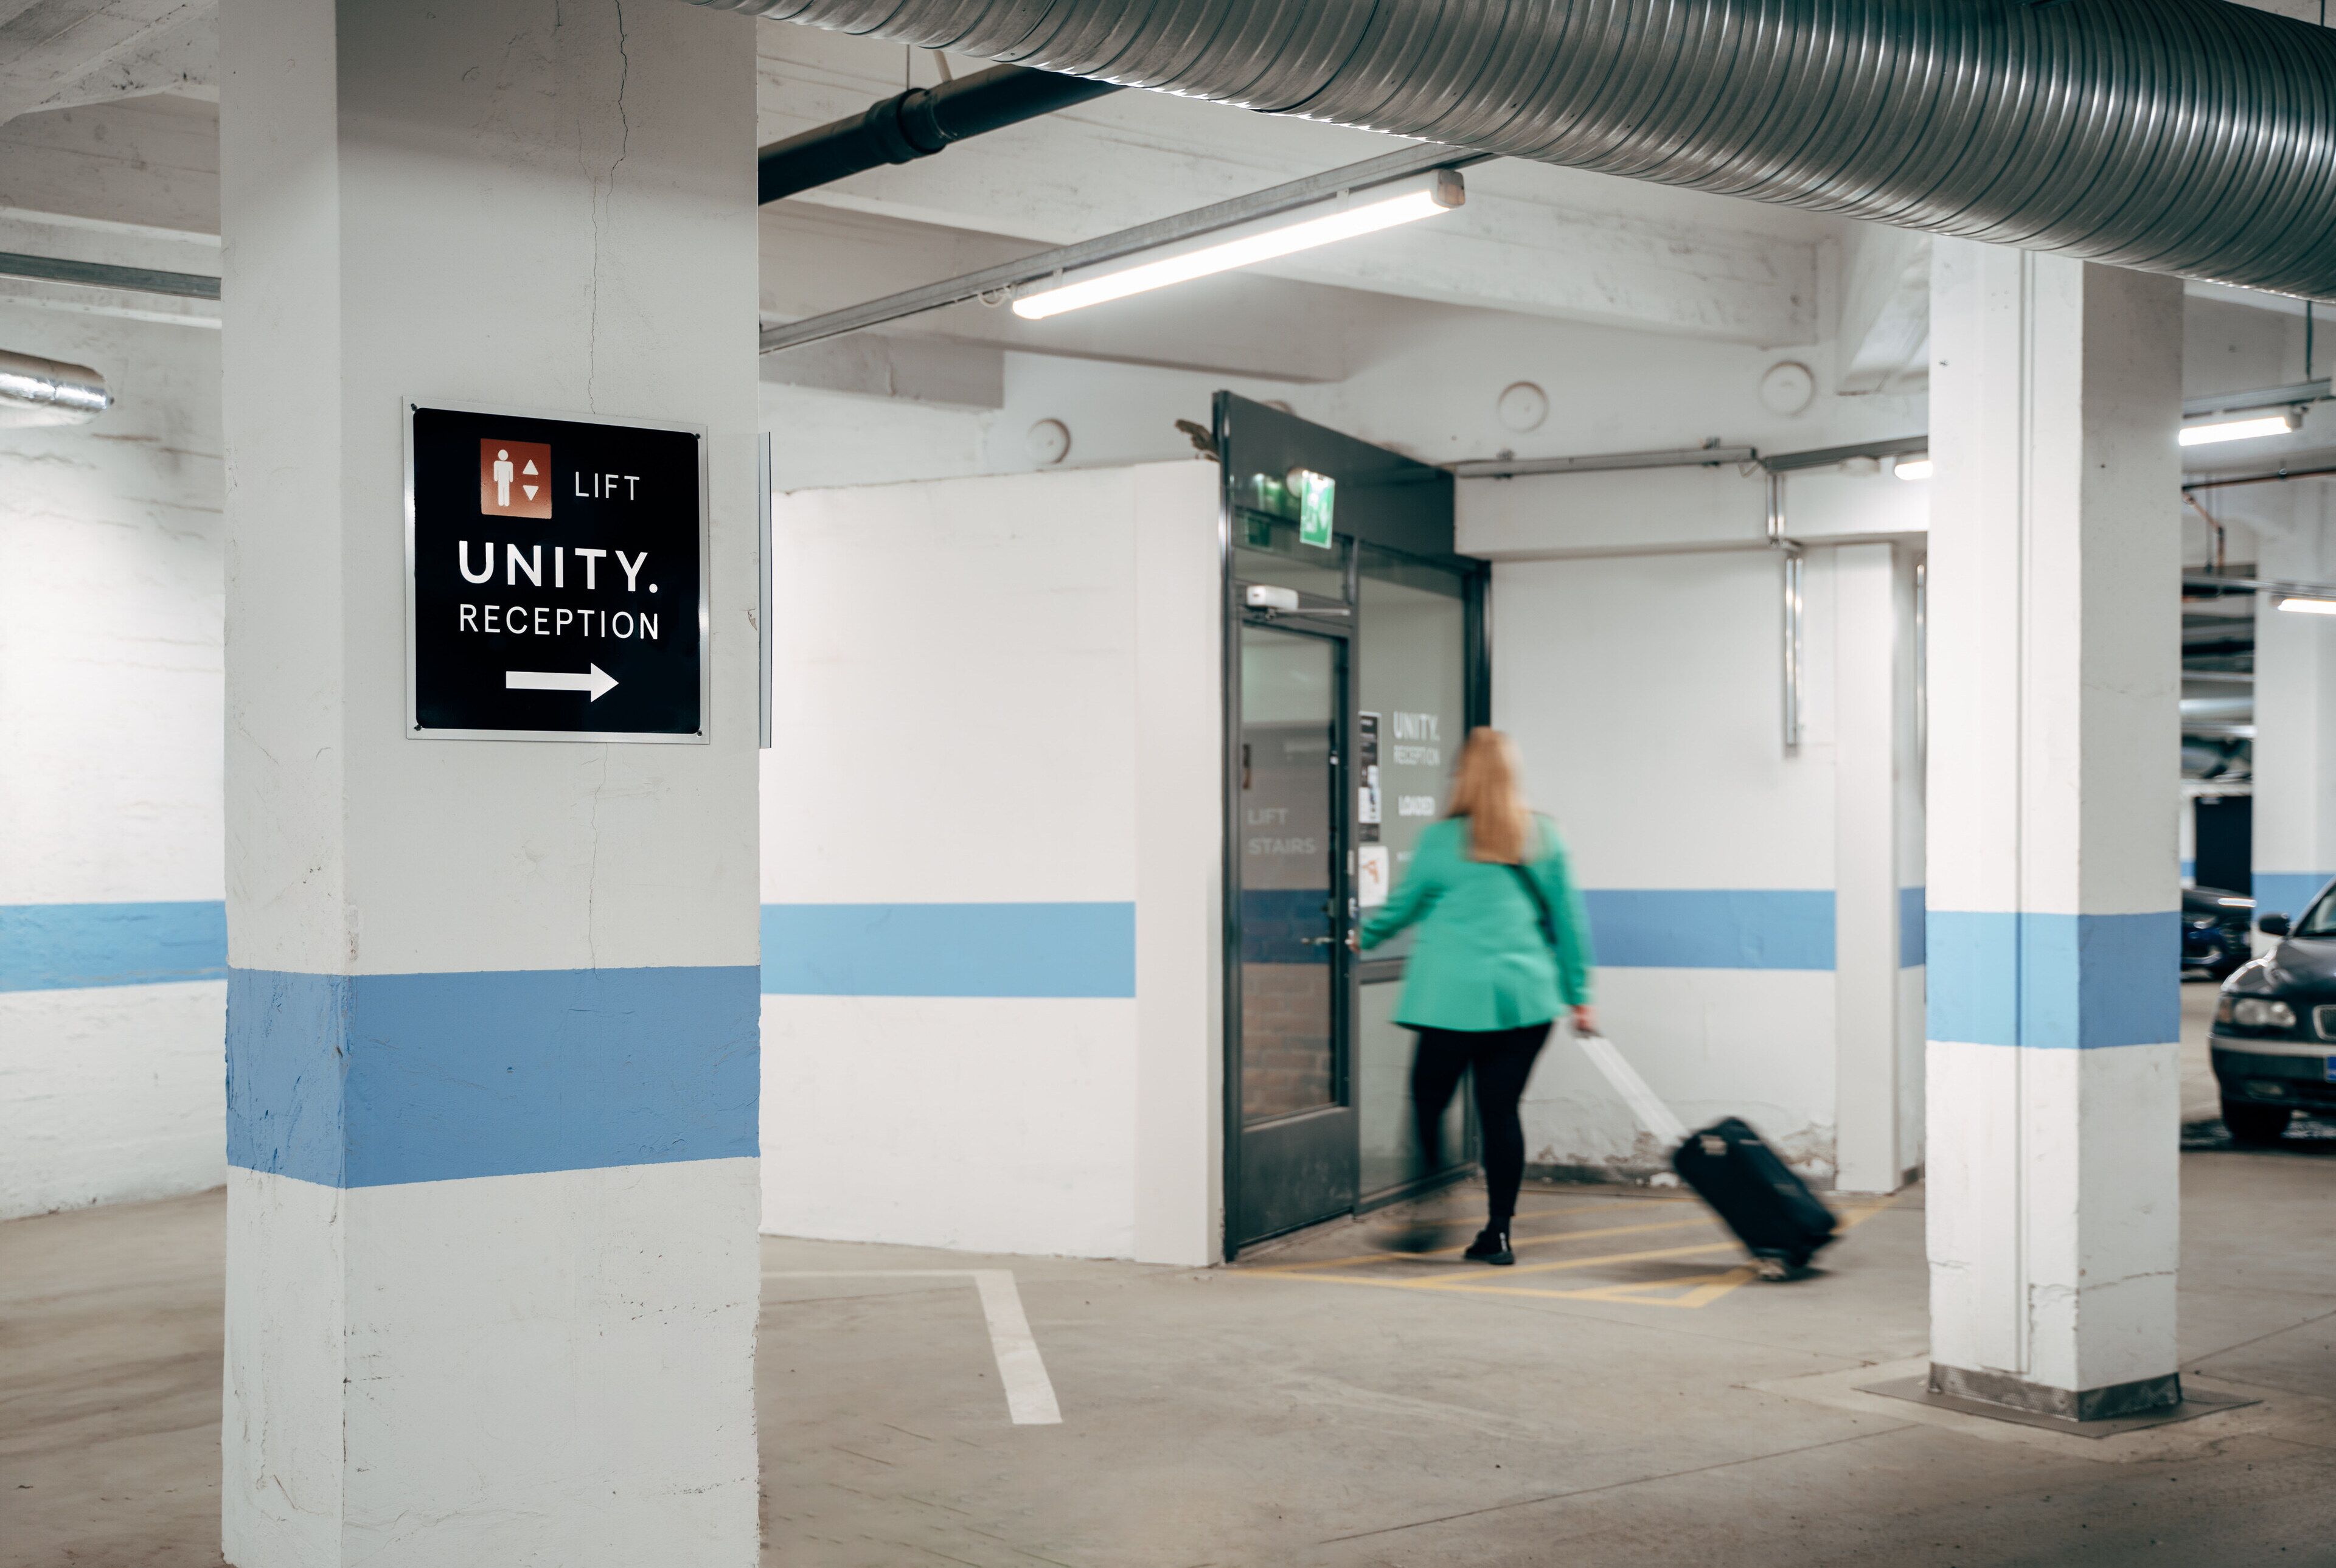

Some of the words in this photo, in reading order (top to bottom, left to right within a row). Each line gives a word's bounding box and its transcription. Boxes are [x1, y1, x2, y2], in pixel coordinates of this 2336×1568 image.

[575, 471, 640, 501] LIFT
[459, 540, 658, 594] UNITY.
[459, 603, 658, 640] RECEPTION
[1246, 807, 1289, 825] LIFT
[1247, 837, 1316, 855] STAIRS
